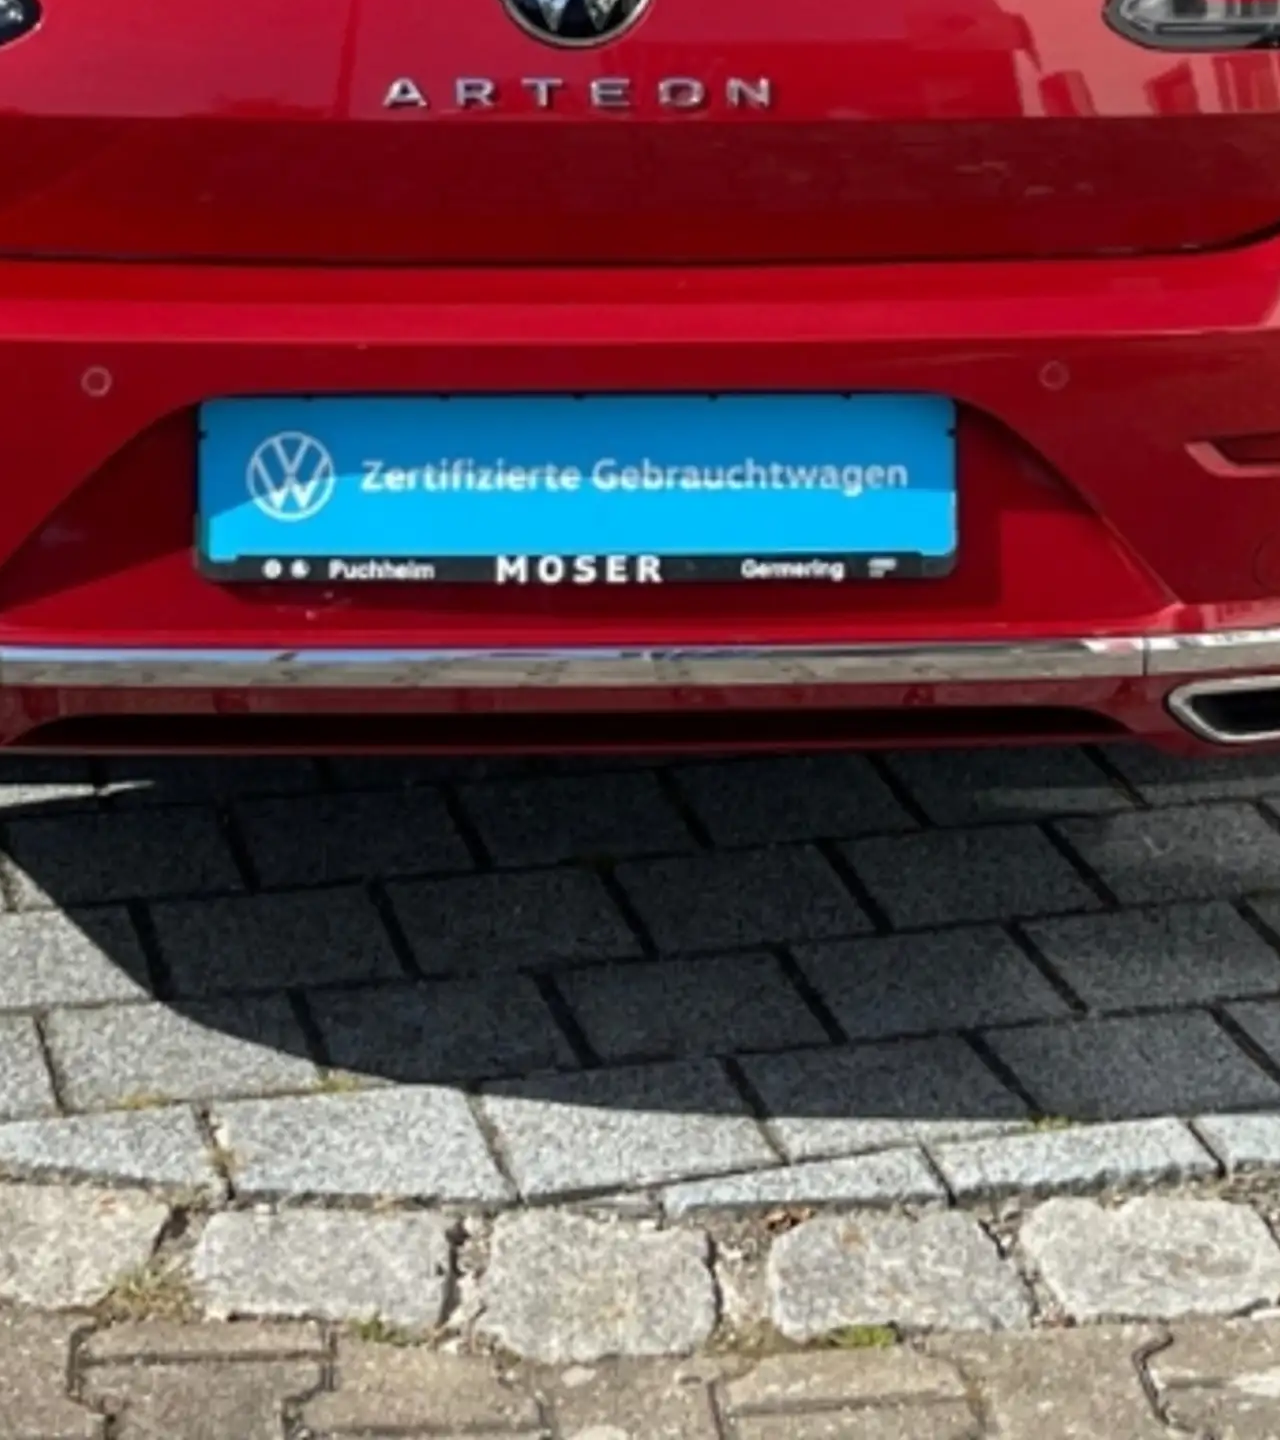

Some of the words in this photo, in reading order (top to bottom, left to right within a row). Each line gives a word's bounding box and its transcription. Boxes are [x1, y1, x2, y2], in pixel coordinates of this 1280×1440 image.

[383, 76, 774, 109] ARTEON
[360, 459, 581, 493] Zertifizierte
[591, 458, 908, 497] Gebrauchtwagen
[328, 559, 435, 580] Puchheim
[495, 554, 664, 584] MOSER
